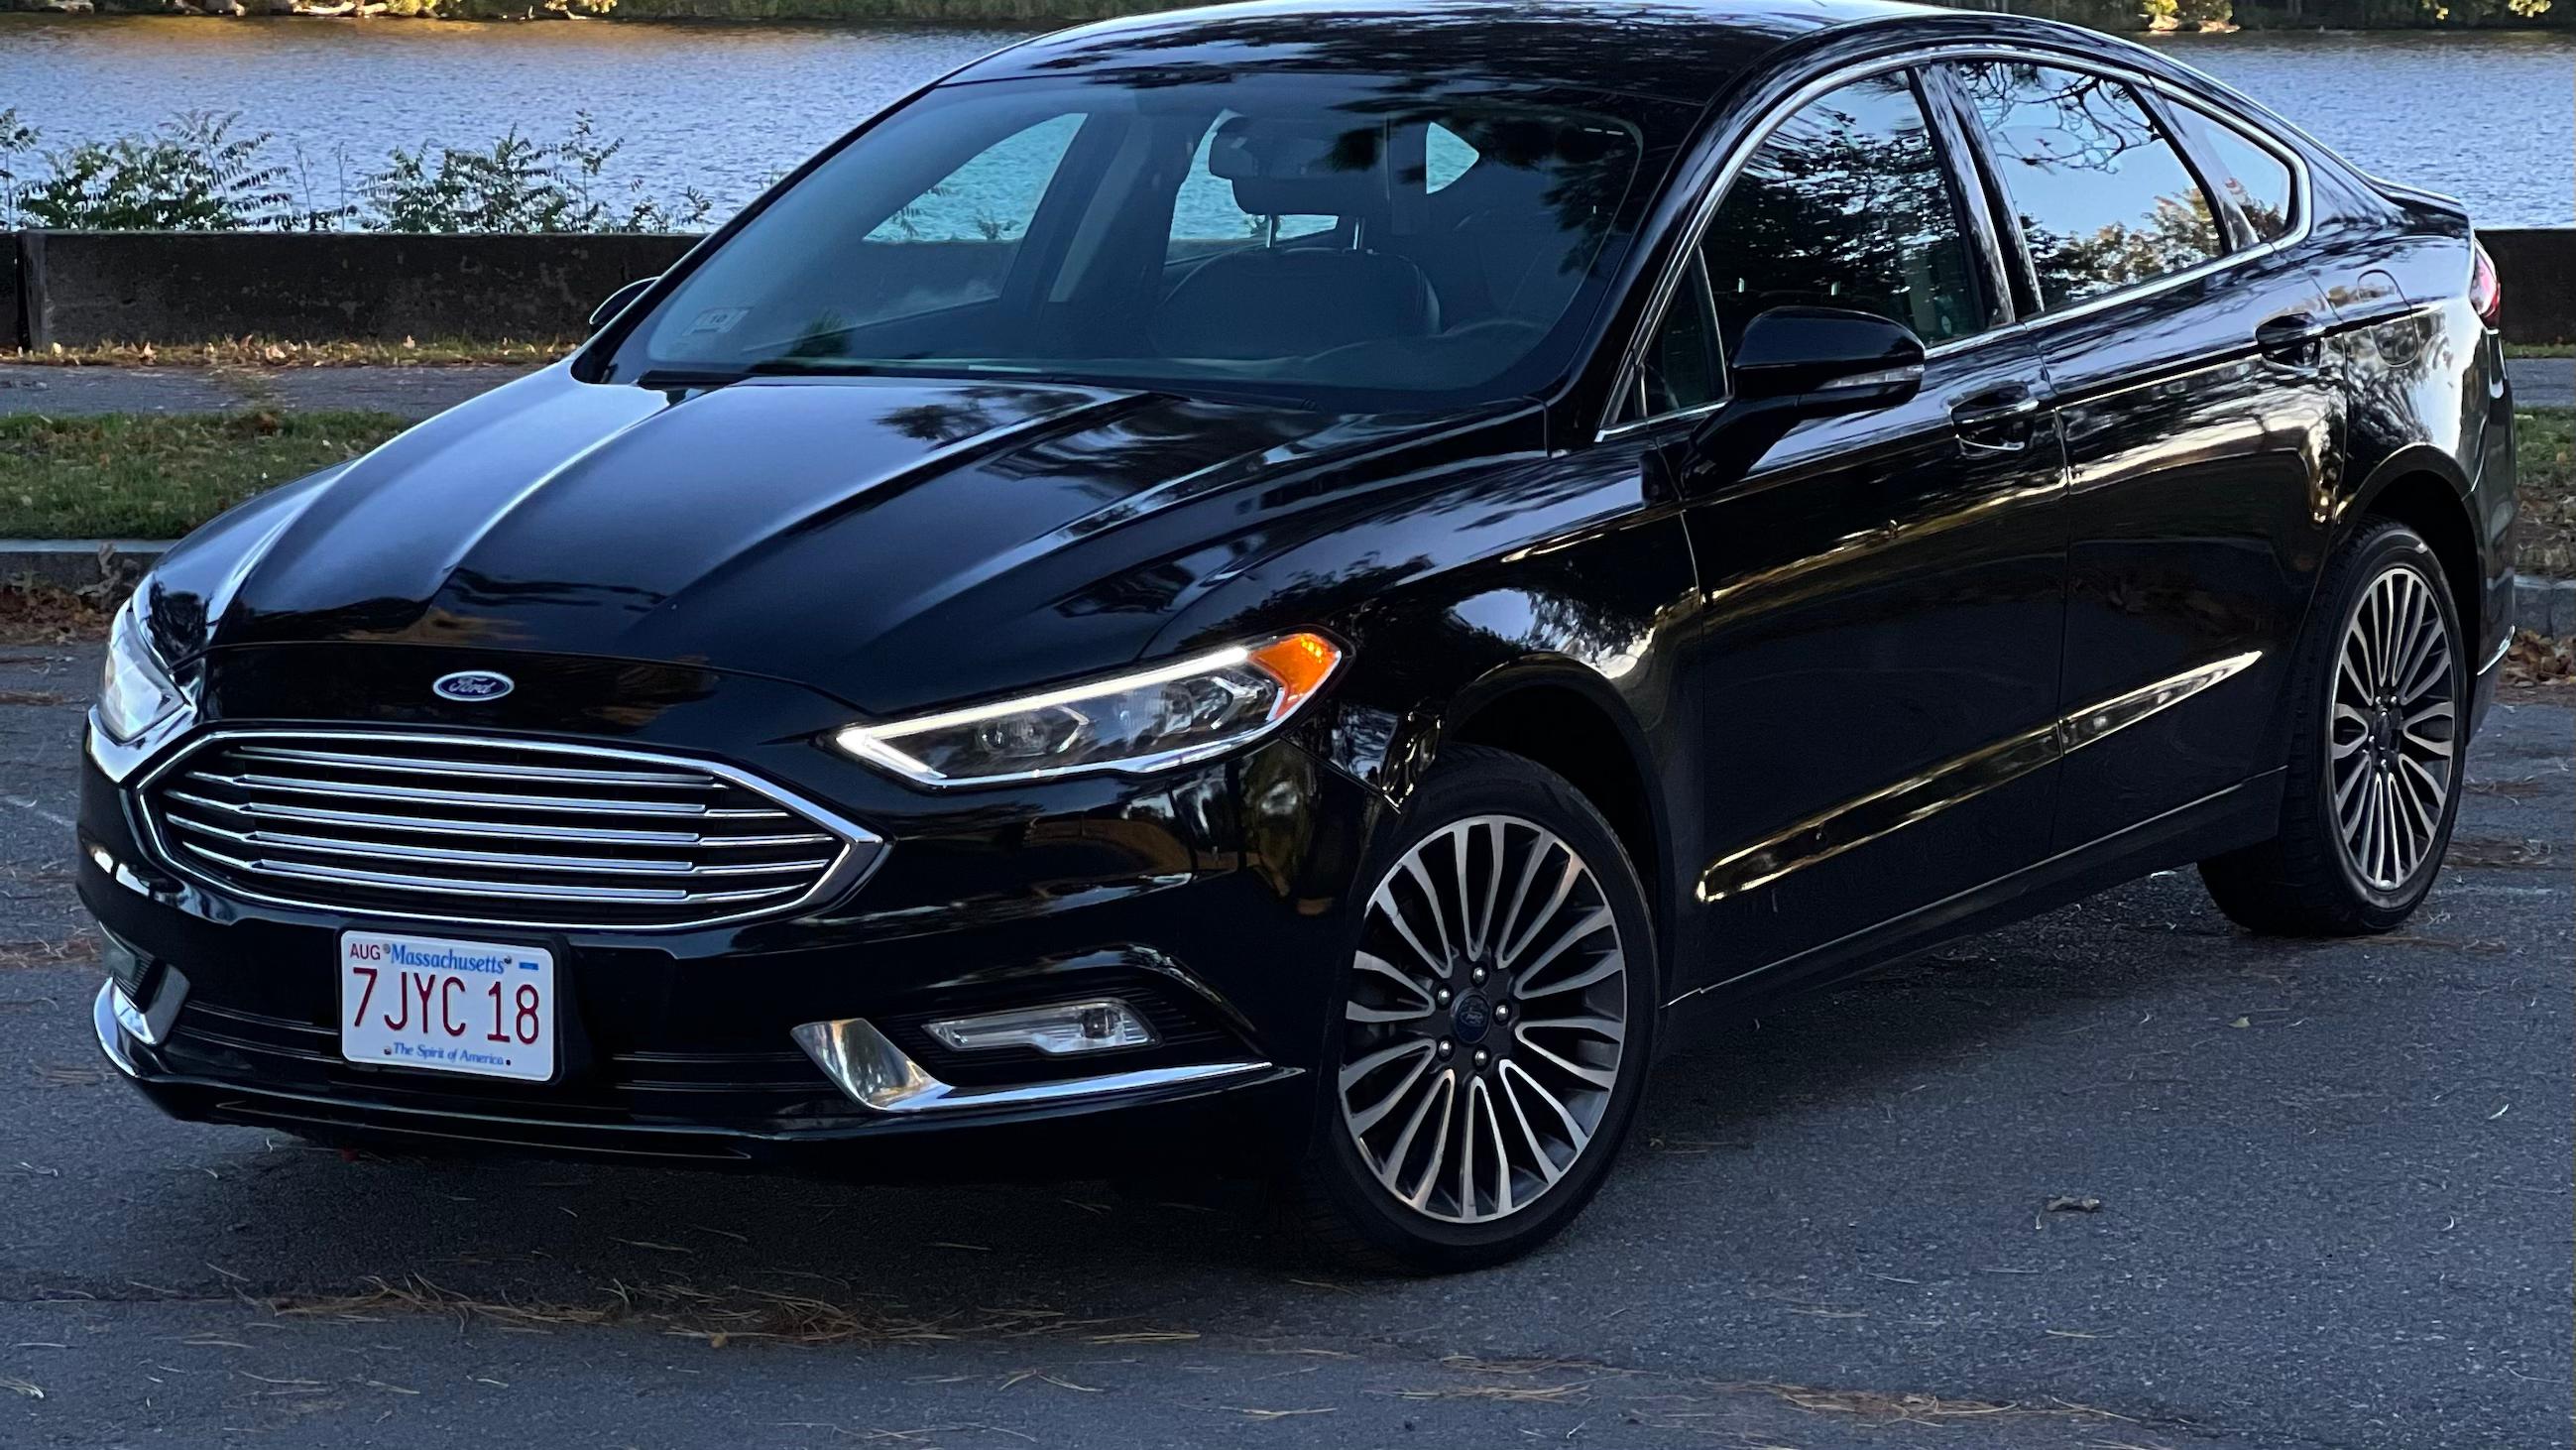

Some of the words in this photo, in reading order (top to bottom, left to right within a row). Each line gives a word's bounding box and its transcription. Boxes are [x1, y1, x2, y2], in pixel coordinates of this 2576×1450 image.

[448, 675, 497, 694] Ford
[350, 943, 381, 961] AUG
[391, 943, 505, 975] Massachusetts
[353, 966, 378, 1027] 7
[384, 971, 467, 1036] JYC
[487, 981, 540, 1045] 18
[394, 1042, 414, 1056] The
[417, 1043, 444, 1060] Spirit
[447, 1046, 458, 1063] of
[459, 1050, 504, 1066] America
